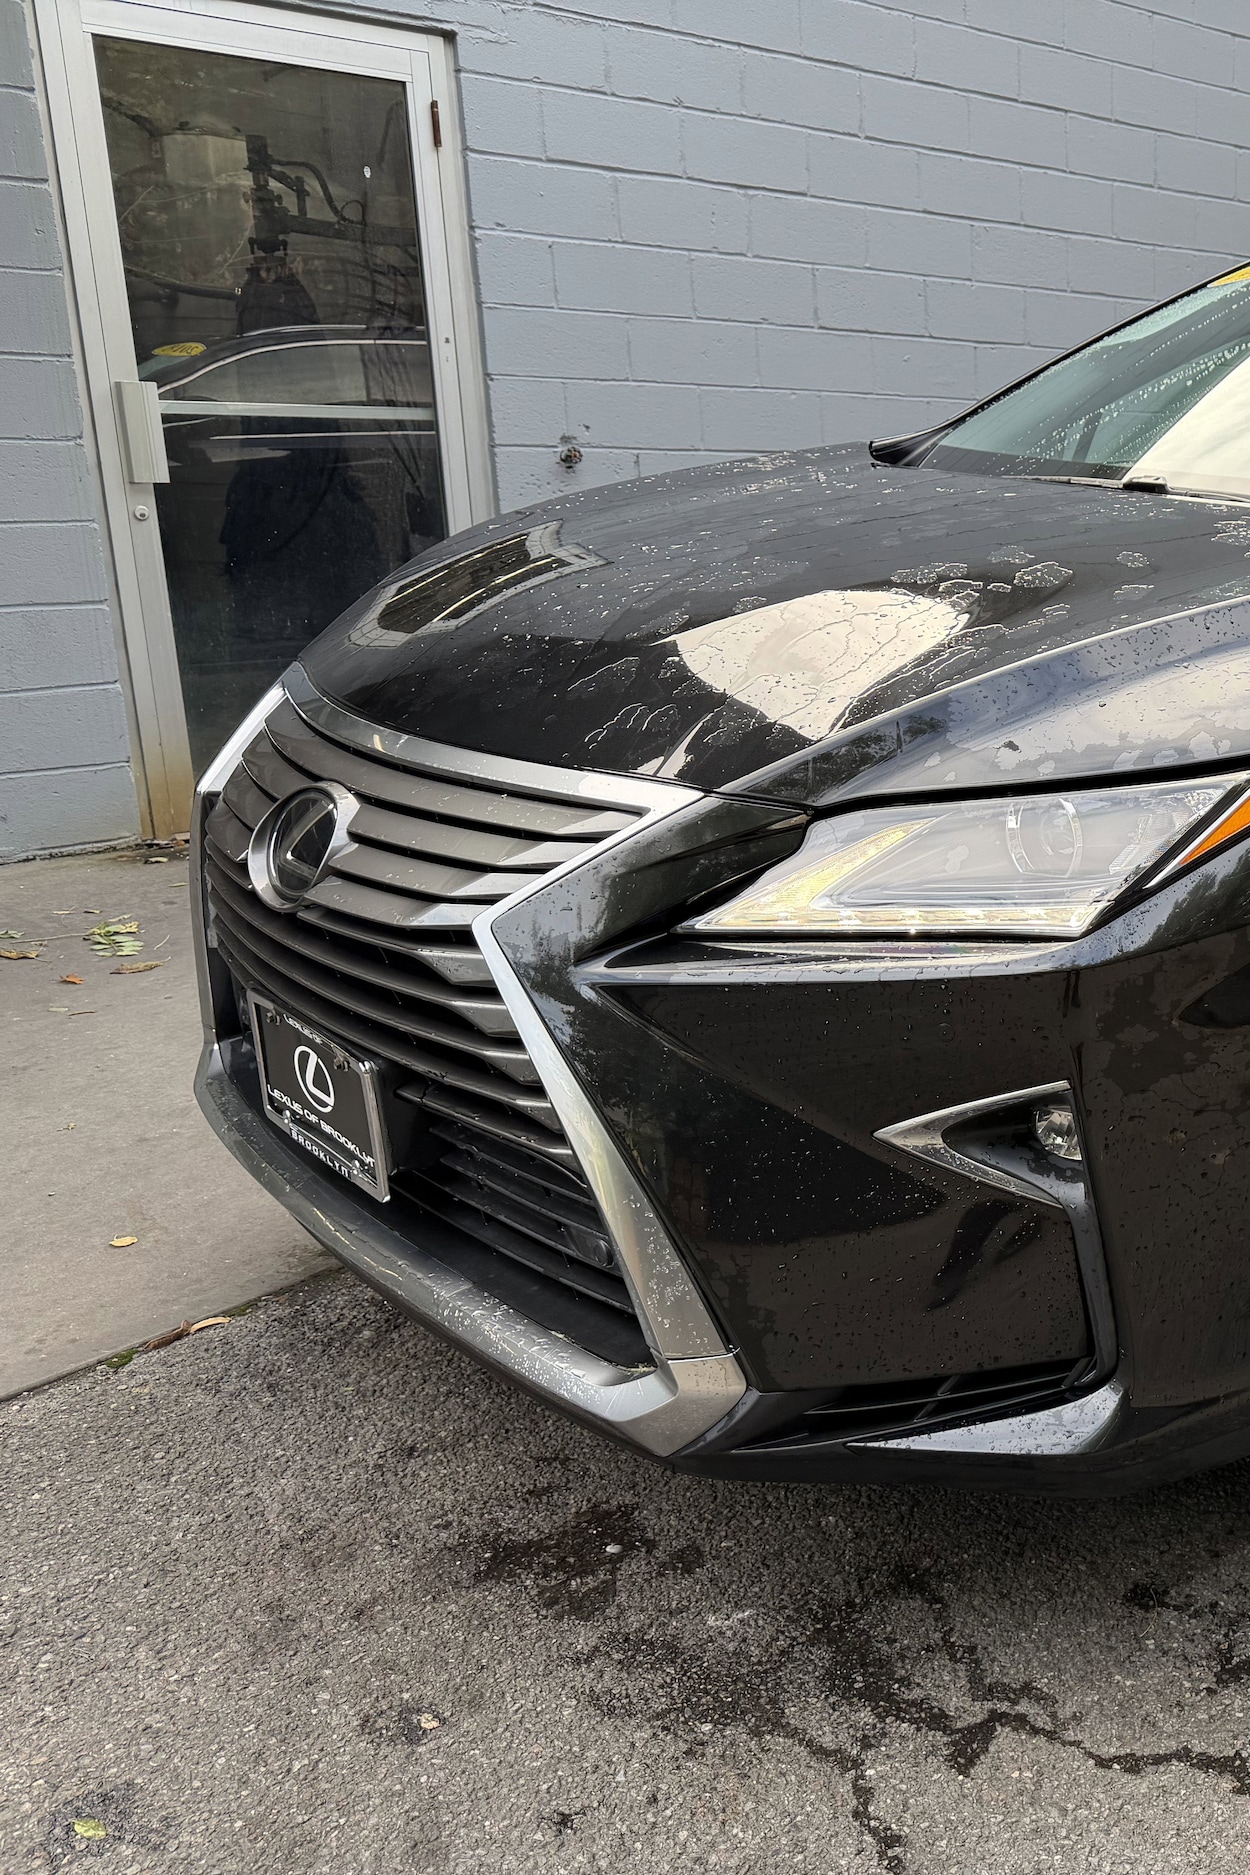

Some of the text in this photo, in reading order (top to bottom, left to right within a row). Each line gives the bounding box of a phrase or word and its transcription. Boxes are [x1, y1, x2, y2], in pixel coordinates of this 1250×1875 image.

[283, 1013, 313, 1039] LEXUS
[267, 1084, 304, 1115] LEXUS
[304, 1109, 319, 1123] OF
[291, 1129, 348, 1177] BROOKLYN
